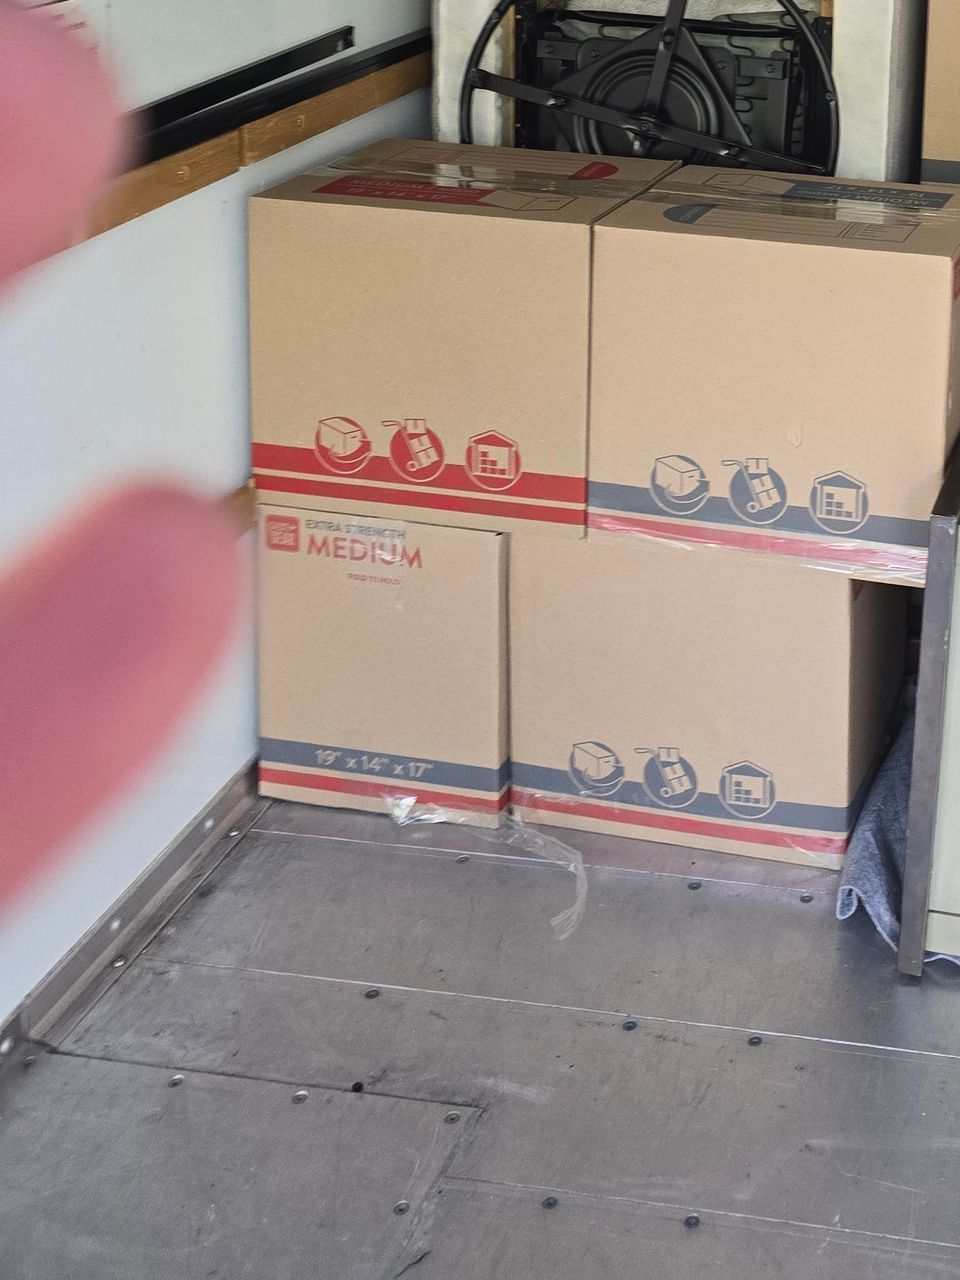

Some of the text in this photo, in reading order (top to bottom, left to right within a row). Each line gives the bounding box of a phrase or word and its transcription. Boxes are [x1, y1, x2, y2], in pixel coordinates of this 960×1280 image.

[349, 179, 423, 189] MEDIUM
[855, 195, 929, 206] MEDIUM
[305, 519, 407, 539] EXTRA STRENGTH
[306, 533, 423, 569] MEDIUM
[315, 749, 435, 778] 19" x 14" x 17"
